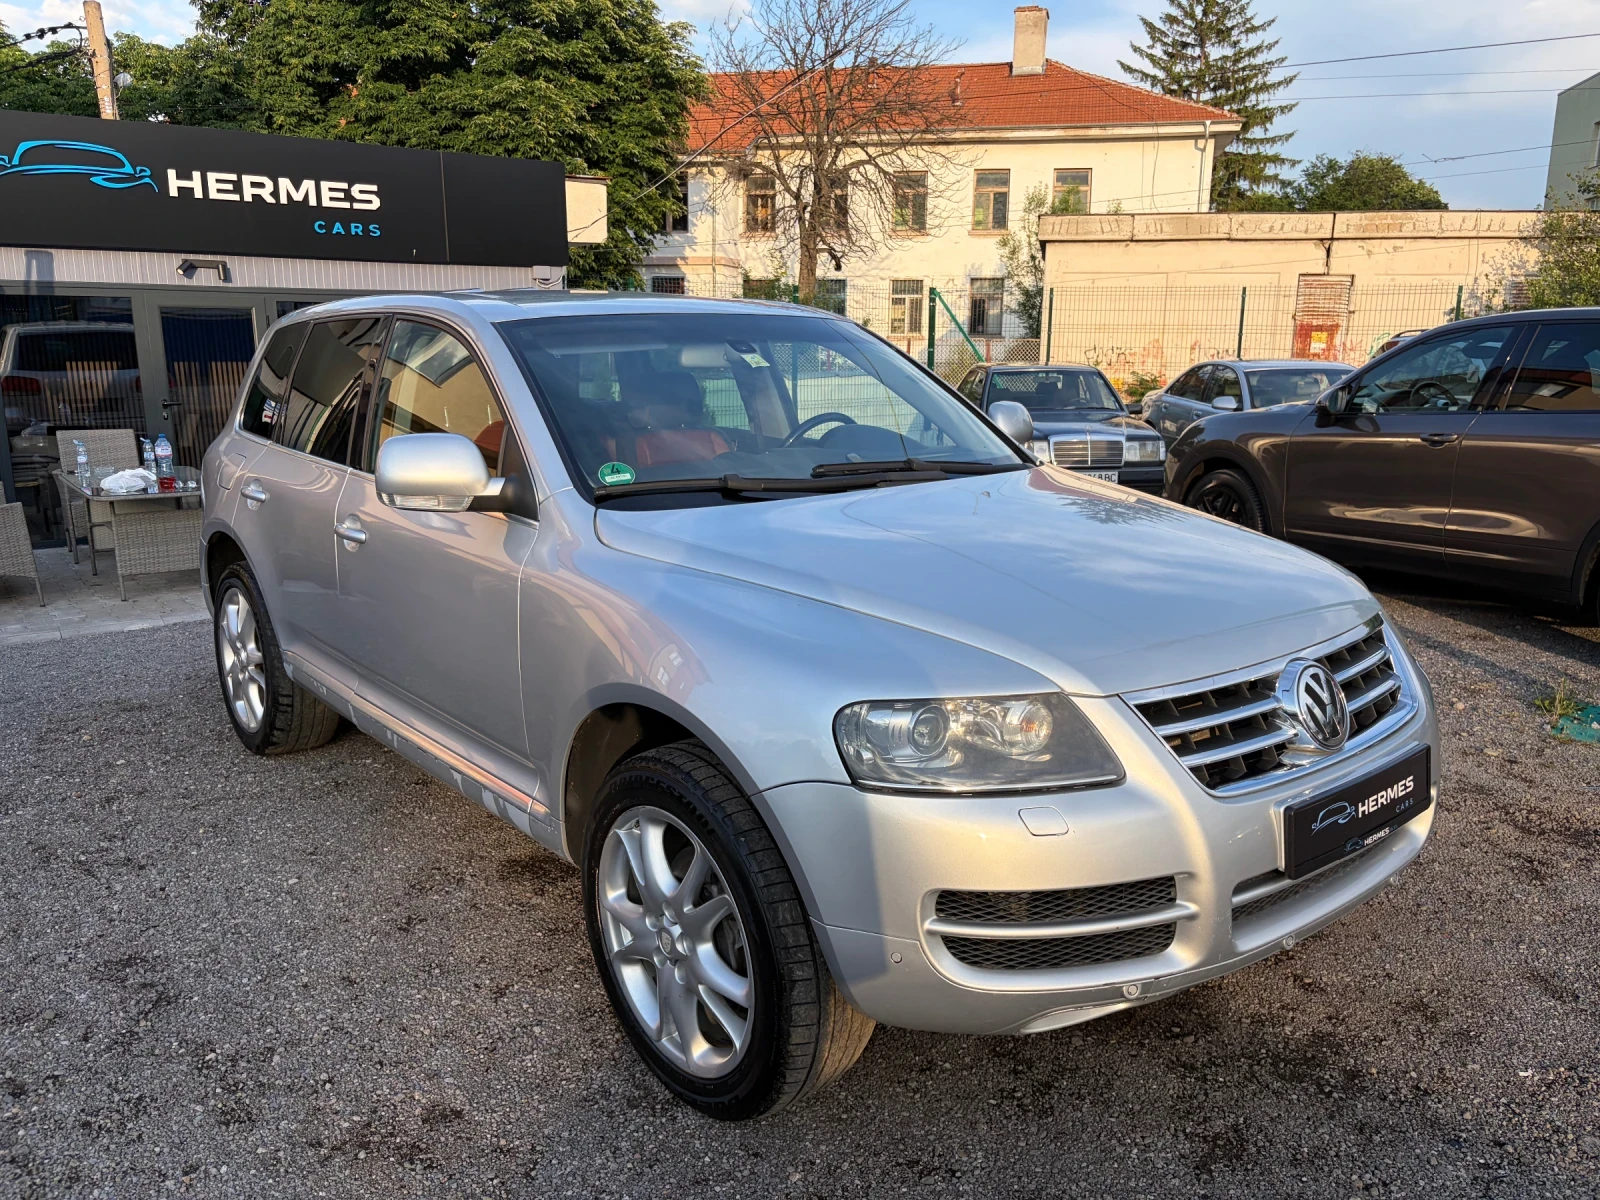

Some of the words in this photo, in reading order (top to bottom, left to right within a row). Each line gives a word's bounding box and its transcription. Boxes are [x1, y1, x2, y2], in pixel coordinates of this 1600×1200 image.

[167, 168, 381, 211] HERMES
[314, 221, 381, 237] CARS
[611, 464, 621, 474] 4
[1358, 775, 1414, 818] HERMES
[1396, 797, 1414, 813] CARS
